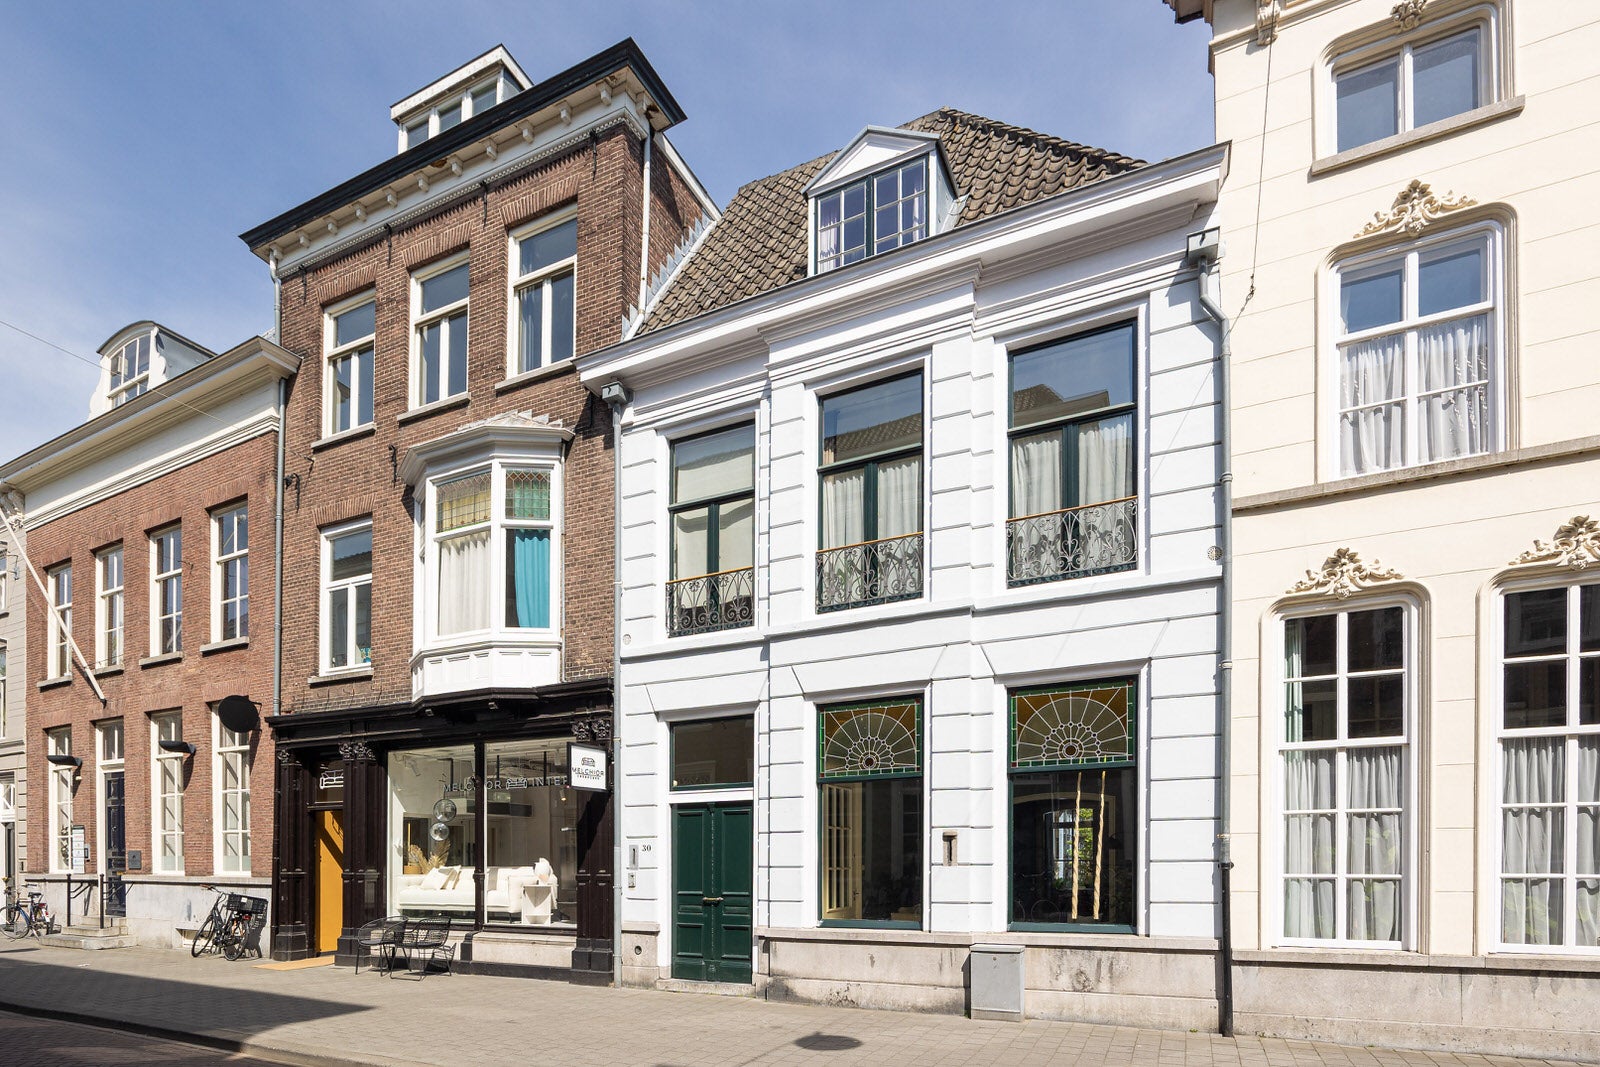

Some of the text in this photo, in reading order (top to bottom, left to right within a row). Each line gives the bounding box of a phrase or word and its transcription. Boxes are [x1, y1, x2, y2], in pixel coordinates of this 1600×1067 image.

[571, 767, 604, 776] MELCHIOR
[443, 780, 502, 792] MELCOR
[641, 844, 652, 852] 30
